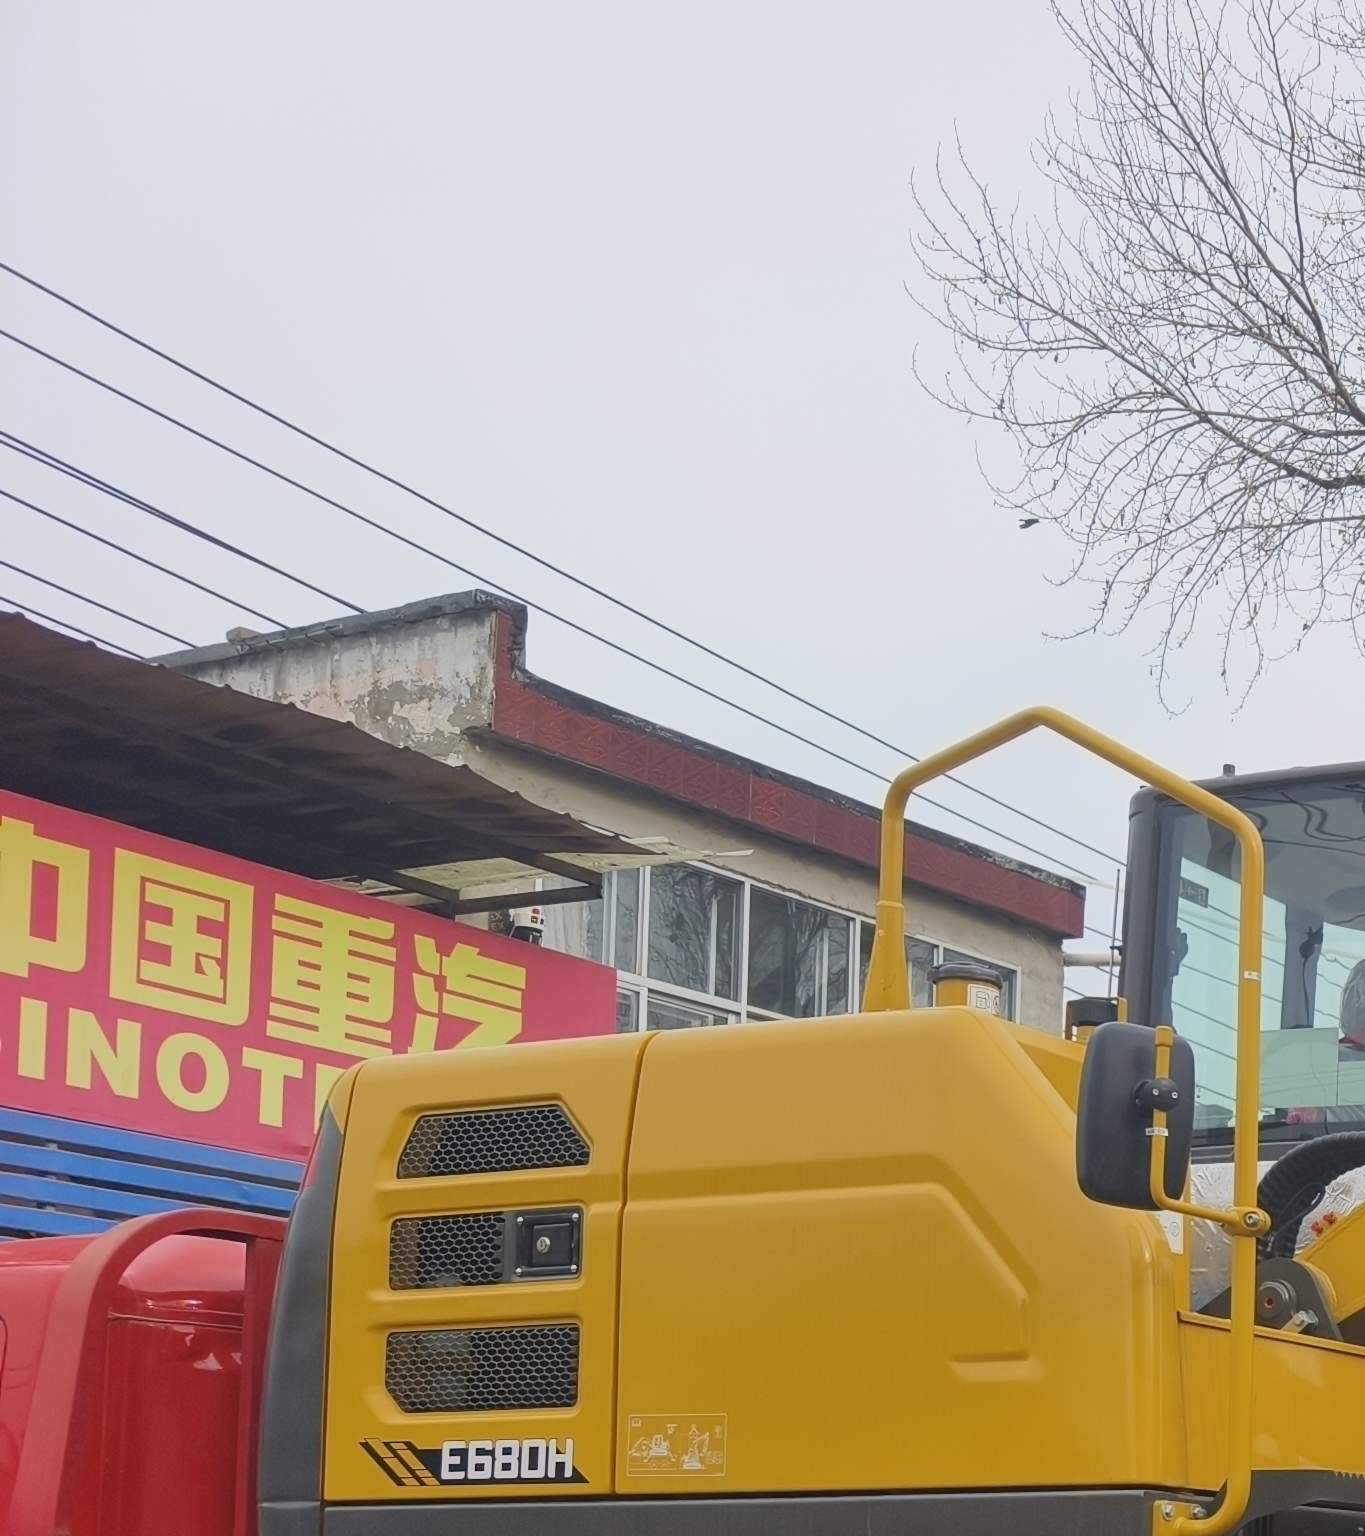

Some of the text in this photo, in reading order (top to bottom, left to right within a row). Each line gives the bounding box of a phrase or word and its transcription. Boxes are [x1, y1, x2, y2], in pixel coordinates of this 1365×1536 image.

[0, 815, 526, 1054] 中国重汽
[0, 997, 343, 1134] INOT
[440, 1439, 574, 1480] E680H
